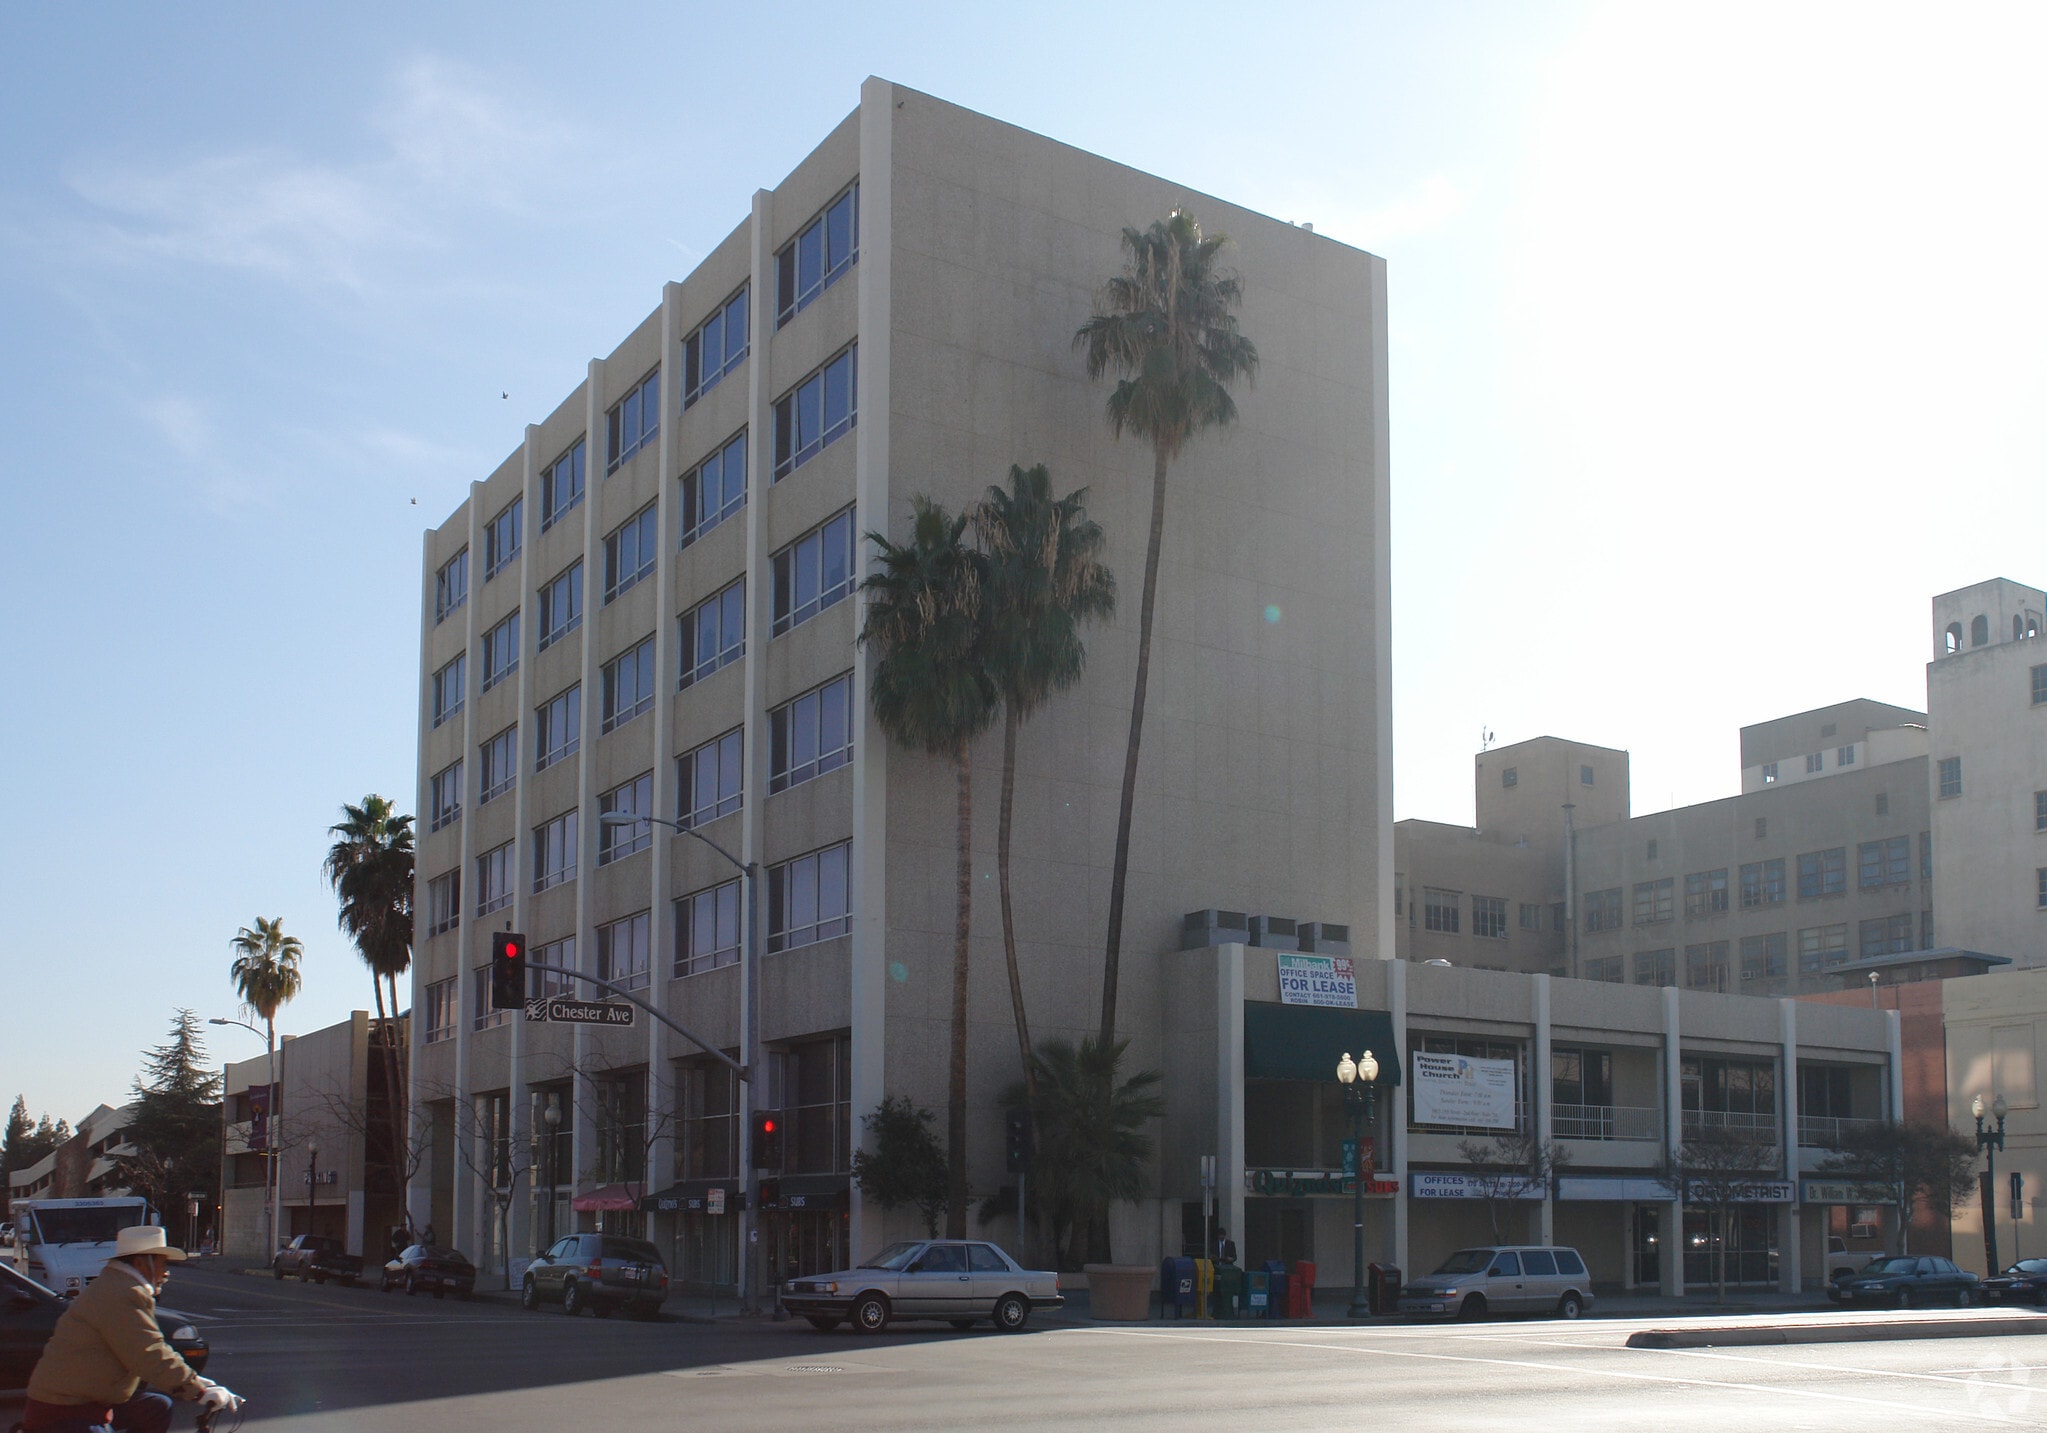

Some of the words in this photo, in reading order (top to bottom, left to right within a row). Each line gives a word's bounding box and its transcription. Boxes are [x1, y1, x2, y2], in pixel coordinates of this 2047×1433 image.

[1280, 969, 1307, 977] OFFICE
[1310, 971, 1334, 979] SPACE
[1282, 978, 1308, 991] FOR
[1313, 981, 1354, 994] LEASE
[552, 1004, 602, 1020] Chester
[607, 1007, 630, 1022] Ave
[1417, 1056, 1452, 1064] Power
[1422, 1071, 1460, 1079] Church
[1424, 1176, 1464, 1185] OFFICES
[1420, 1188, 1437, 1196] FOR
[1439, 1189, 1464, 1197] LEASE
